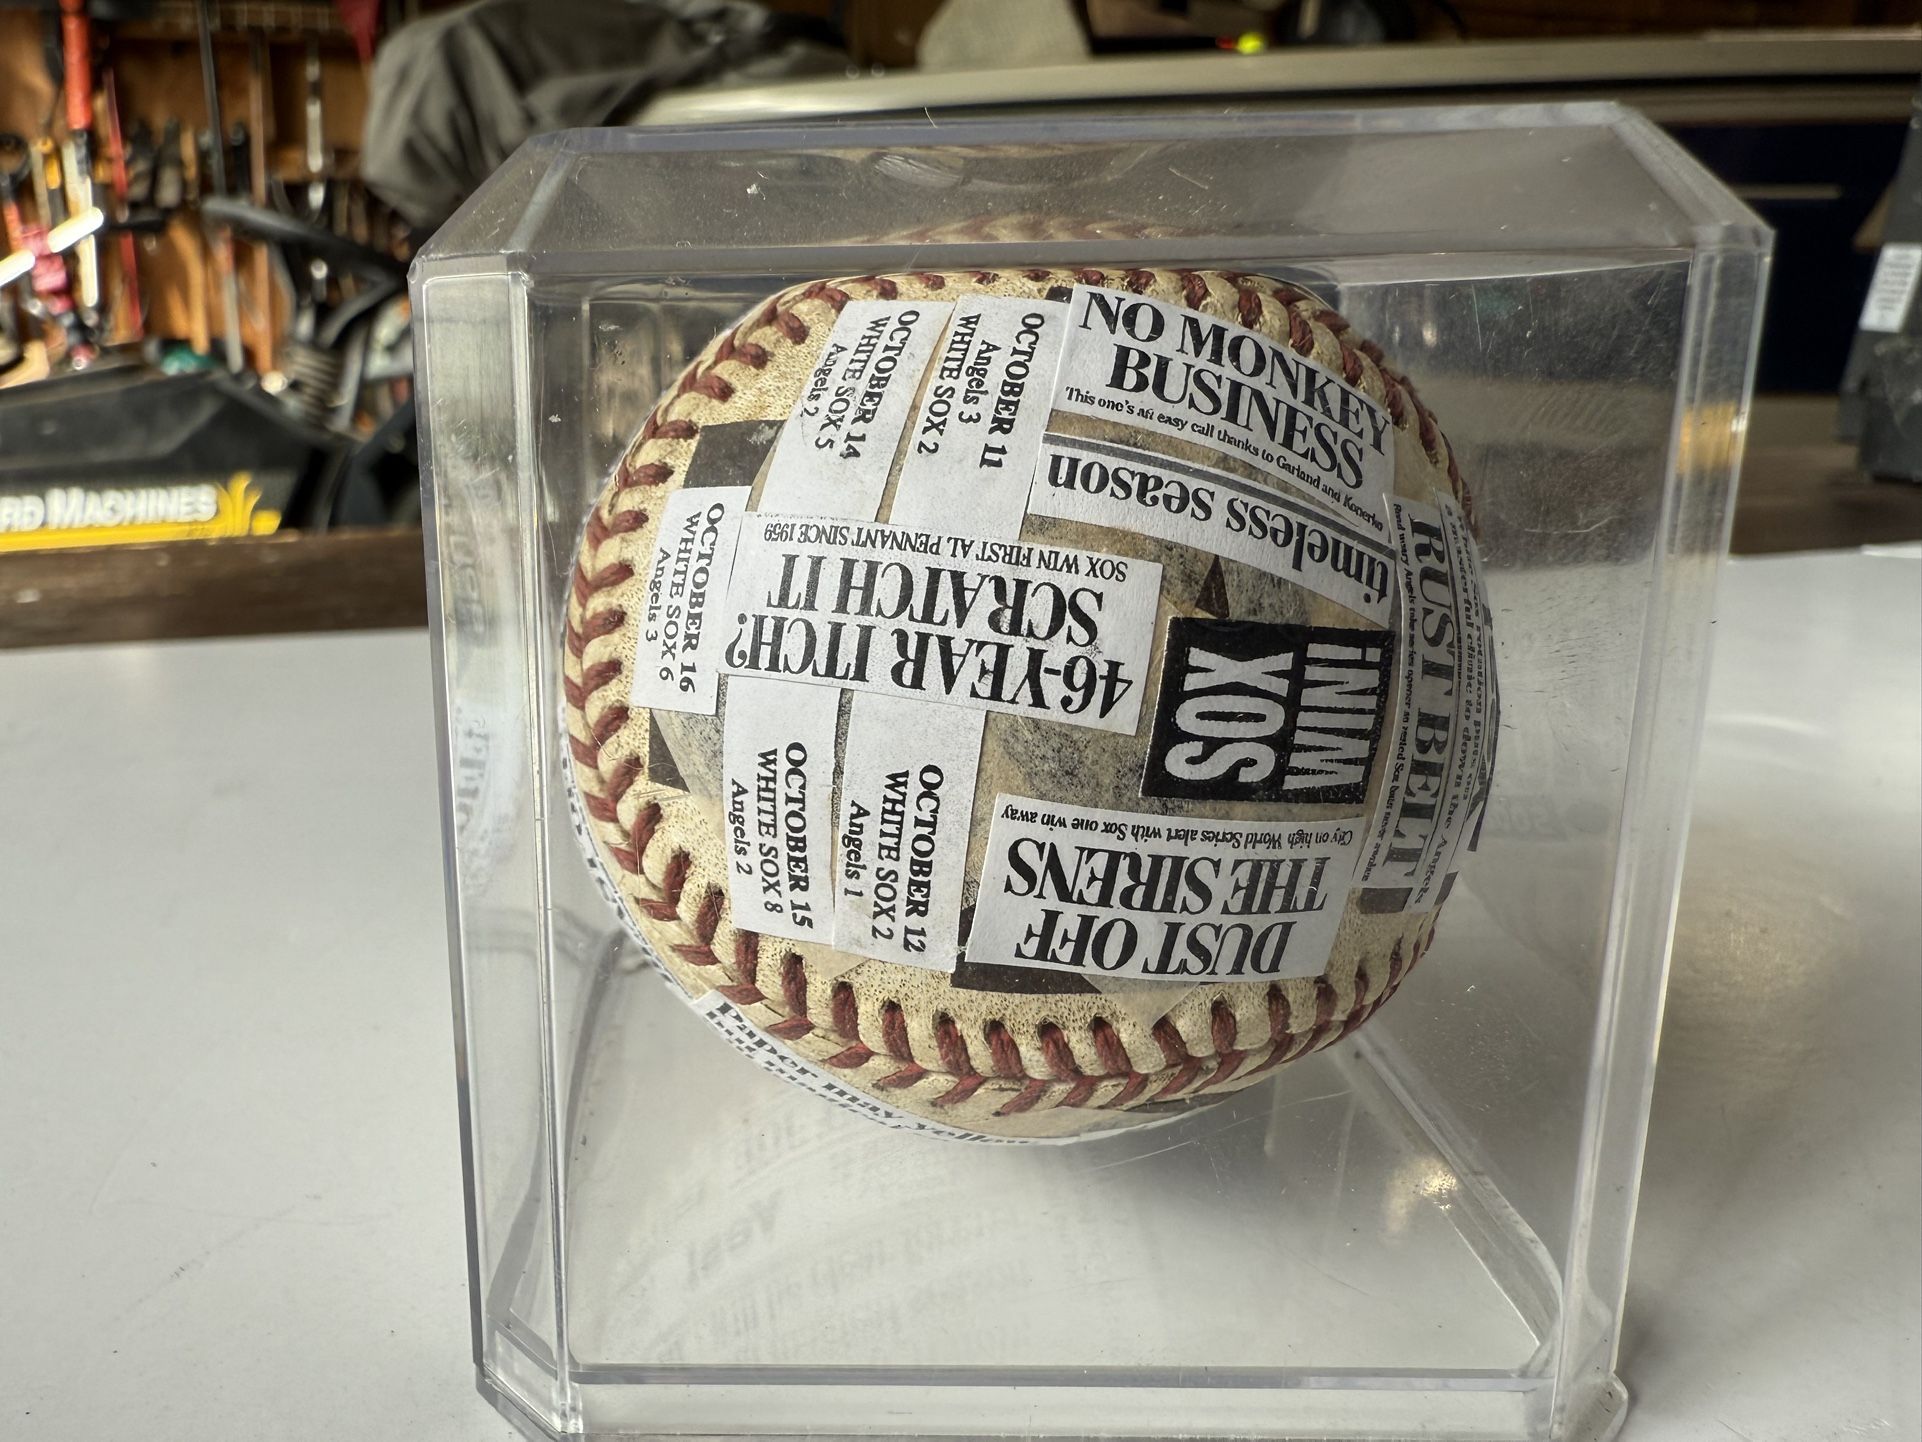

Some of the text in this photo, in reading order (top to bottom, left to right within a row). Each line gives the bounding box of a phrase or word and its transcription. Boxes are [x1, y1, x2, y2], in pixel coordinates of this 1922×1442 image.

[800, 343, 848, 418] Angels 2
[815, 315, 892, 450] WHITE SOX 5
[839, 310, 920, 460] OCTOBER 14
[917, 313, 982, 455] WHITE SOX 2
[958, 340, 1002, 424] Angels 3
[978, 312, 1045, 469] OCTOBER 11
[1079, 291, 1392, 457] NO MONKEY
[1105, 343, 1364, 490] BUSINESS
[1065, 386, 1384, 532] This one's an easy call thanks to Garland and Konerko
[764, 522, 1129, 583] SOX WIN FIRST AL PENNANT SINCE 1959
[1048, 453, 1390, 606] timeless season
[645, 547, 671, 642] Angels 3
[659, 511, 702, 682] WHITE SOX 6
[679, 502, 725, 693] OCTOBER 16
[766, 553, 1104, 648] SCRATCH IT
[1404, 568, 1416, 605] Angels
[724, 612, 1134, 719] 46-YEAR ITCH?
[1164, 646, 1295, 784] SOX
[1282, 642, 1382, 791] WIN!
[1383, 514, 1455, 876] RUST BELT
[1404, 670, 1414, 708] opener
[1463, 699, 1473, 721] to
[1391, 761, 1405, 783] Sox
[1445, 792, 1459, 830] the
[1454, 725, 1472, 788] down
[728, 778, 753, 876] Angels 2
[756, 748, 784, 914] WHITE SOX 8
[784, 741, 814, 930] OCTOBER 15
[841, 799, 871, 898] Angels 1
[872, 769, 910, 940] WHITE SOX 2
[903, 763, 945, 953] OCTOBER 12
[1001, 803, 1354, 850] City on high World Series alert with Sox one win away
[1003, 836, 1332, 916] THE SIRENS
[1415, 833, 1448, 905] Angels
[1014, 908, 1298, 976] DUST OFF
[716, 1002, 818, 1078] Paper
[822, 1082, 904, 1119] may
